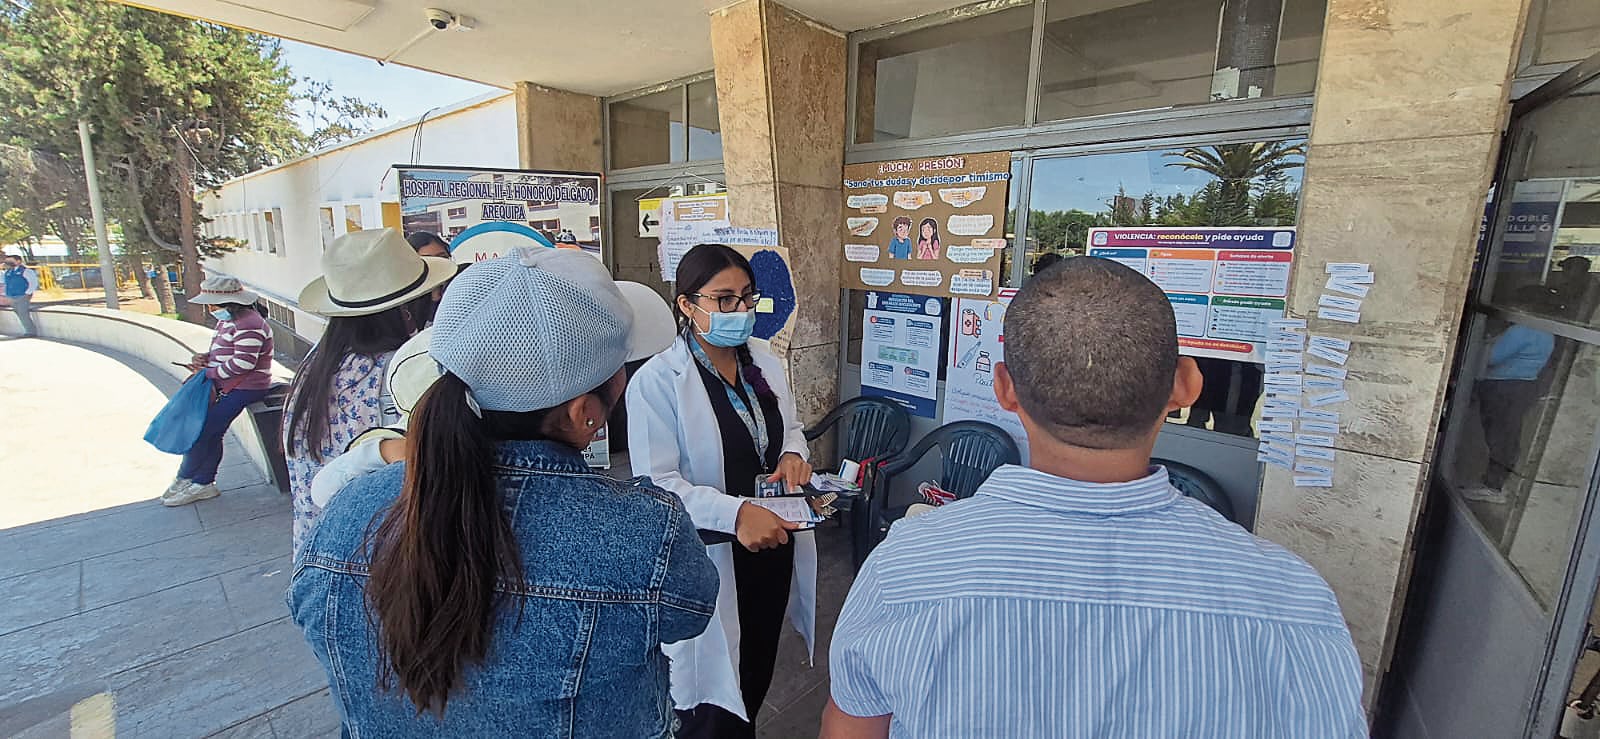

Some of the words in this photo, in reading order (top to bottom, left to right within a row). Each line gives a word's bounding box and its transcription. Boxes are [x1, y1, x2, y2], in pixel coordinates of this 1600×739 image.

[404, 180, 448, 197] HOSPITAL
[449, 183, 493, 198] REGIONAL
[514, 185, 555, 201] HONORIO
[555, 186, 594, 203] DELGADO
[482, 205, 526, 219] AREQUIPA
[1157, 232, 1203, 240] reconócela
[1212, 233, 1232, 242] pide
[1233, 233, 1264, 242] ayuda
